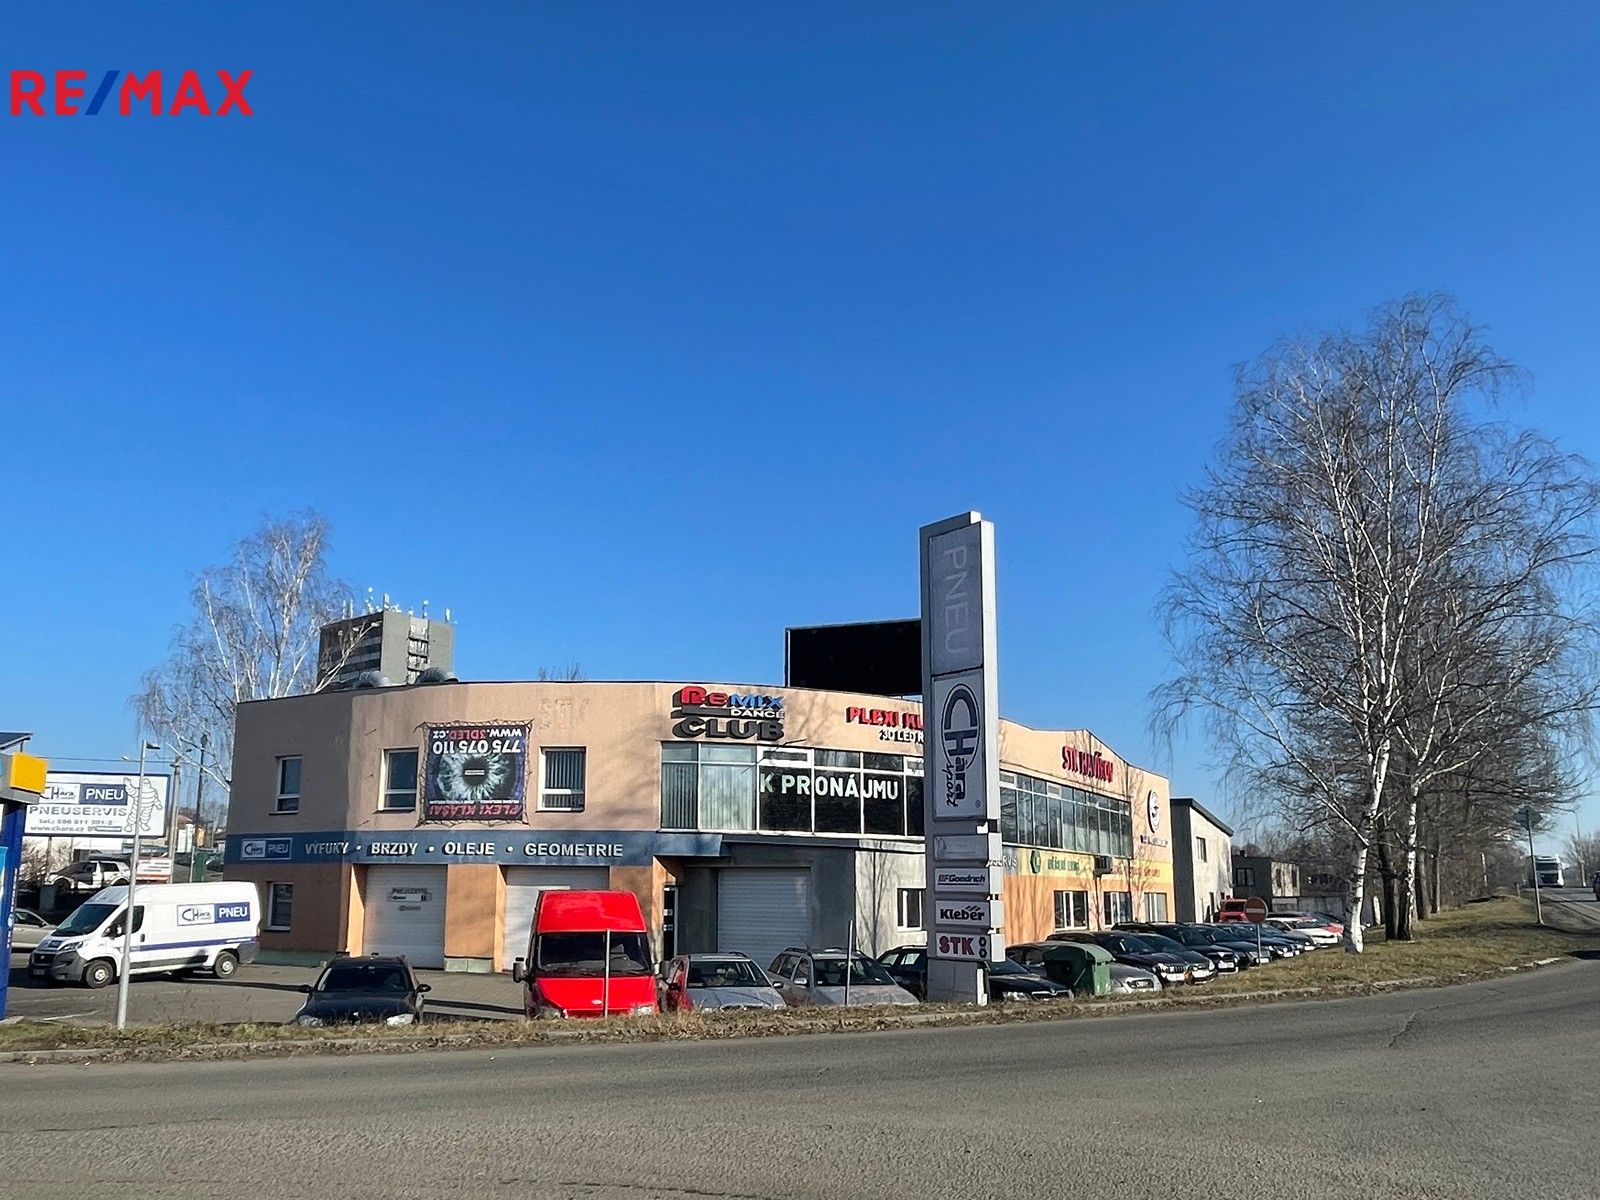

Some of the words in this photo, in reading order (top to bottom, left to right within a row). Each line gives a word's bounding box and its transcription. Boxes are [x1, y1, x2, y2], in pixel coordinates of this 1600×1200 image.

[944, 545, 968, 654] PNEU
[730, 708, 785, 718] DANCE
[846, 707, 899, 727] PLEXI
[432, 729, 522, 739] www.3DLED.cz
[672, 716, 785, 740] CLUB
[432, 741, 455, 755] 110
[458, 740, 489, 754] 075
[492, 740, 521, 754] 775
[760, 773, 774, 793] K
[781, 774, 899, 800] PRONÁJMU
[85, 788, 124, 800] PNEU
[29, 806, 127, 816] PNEUSERVIS
[371, 842, 418, 855] BRZDY
[444, 841, 495, 855] OLEJE
[525, 842, 623, 856] GEOMETRIE
[219, 906, 248, 918] PNEU
[939, 936, 975, 956] STK
